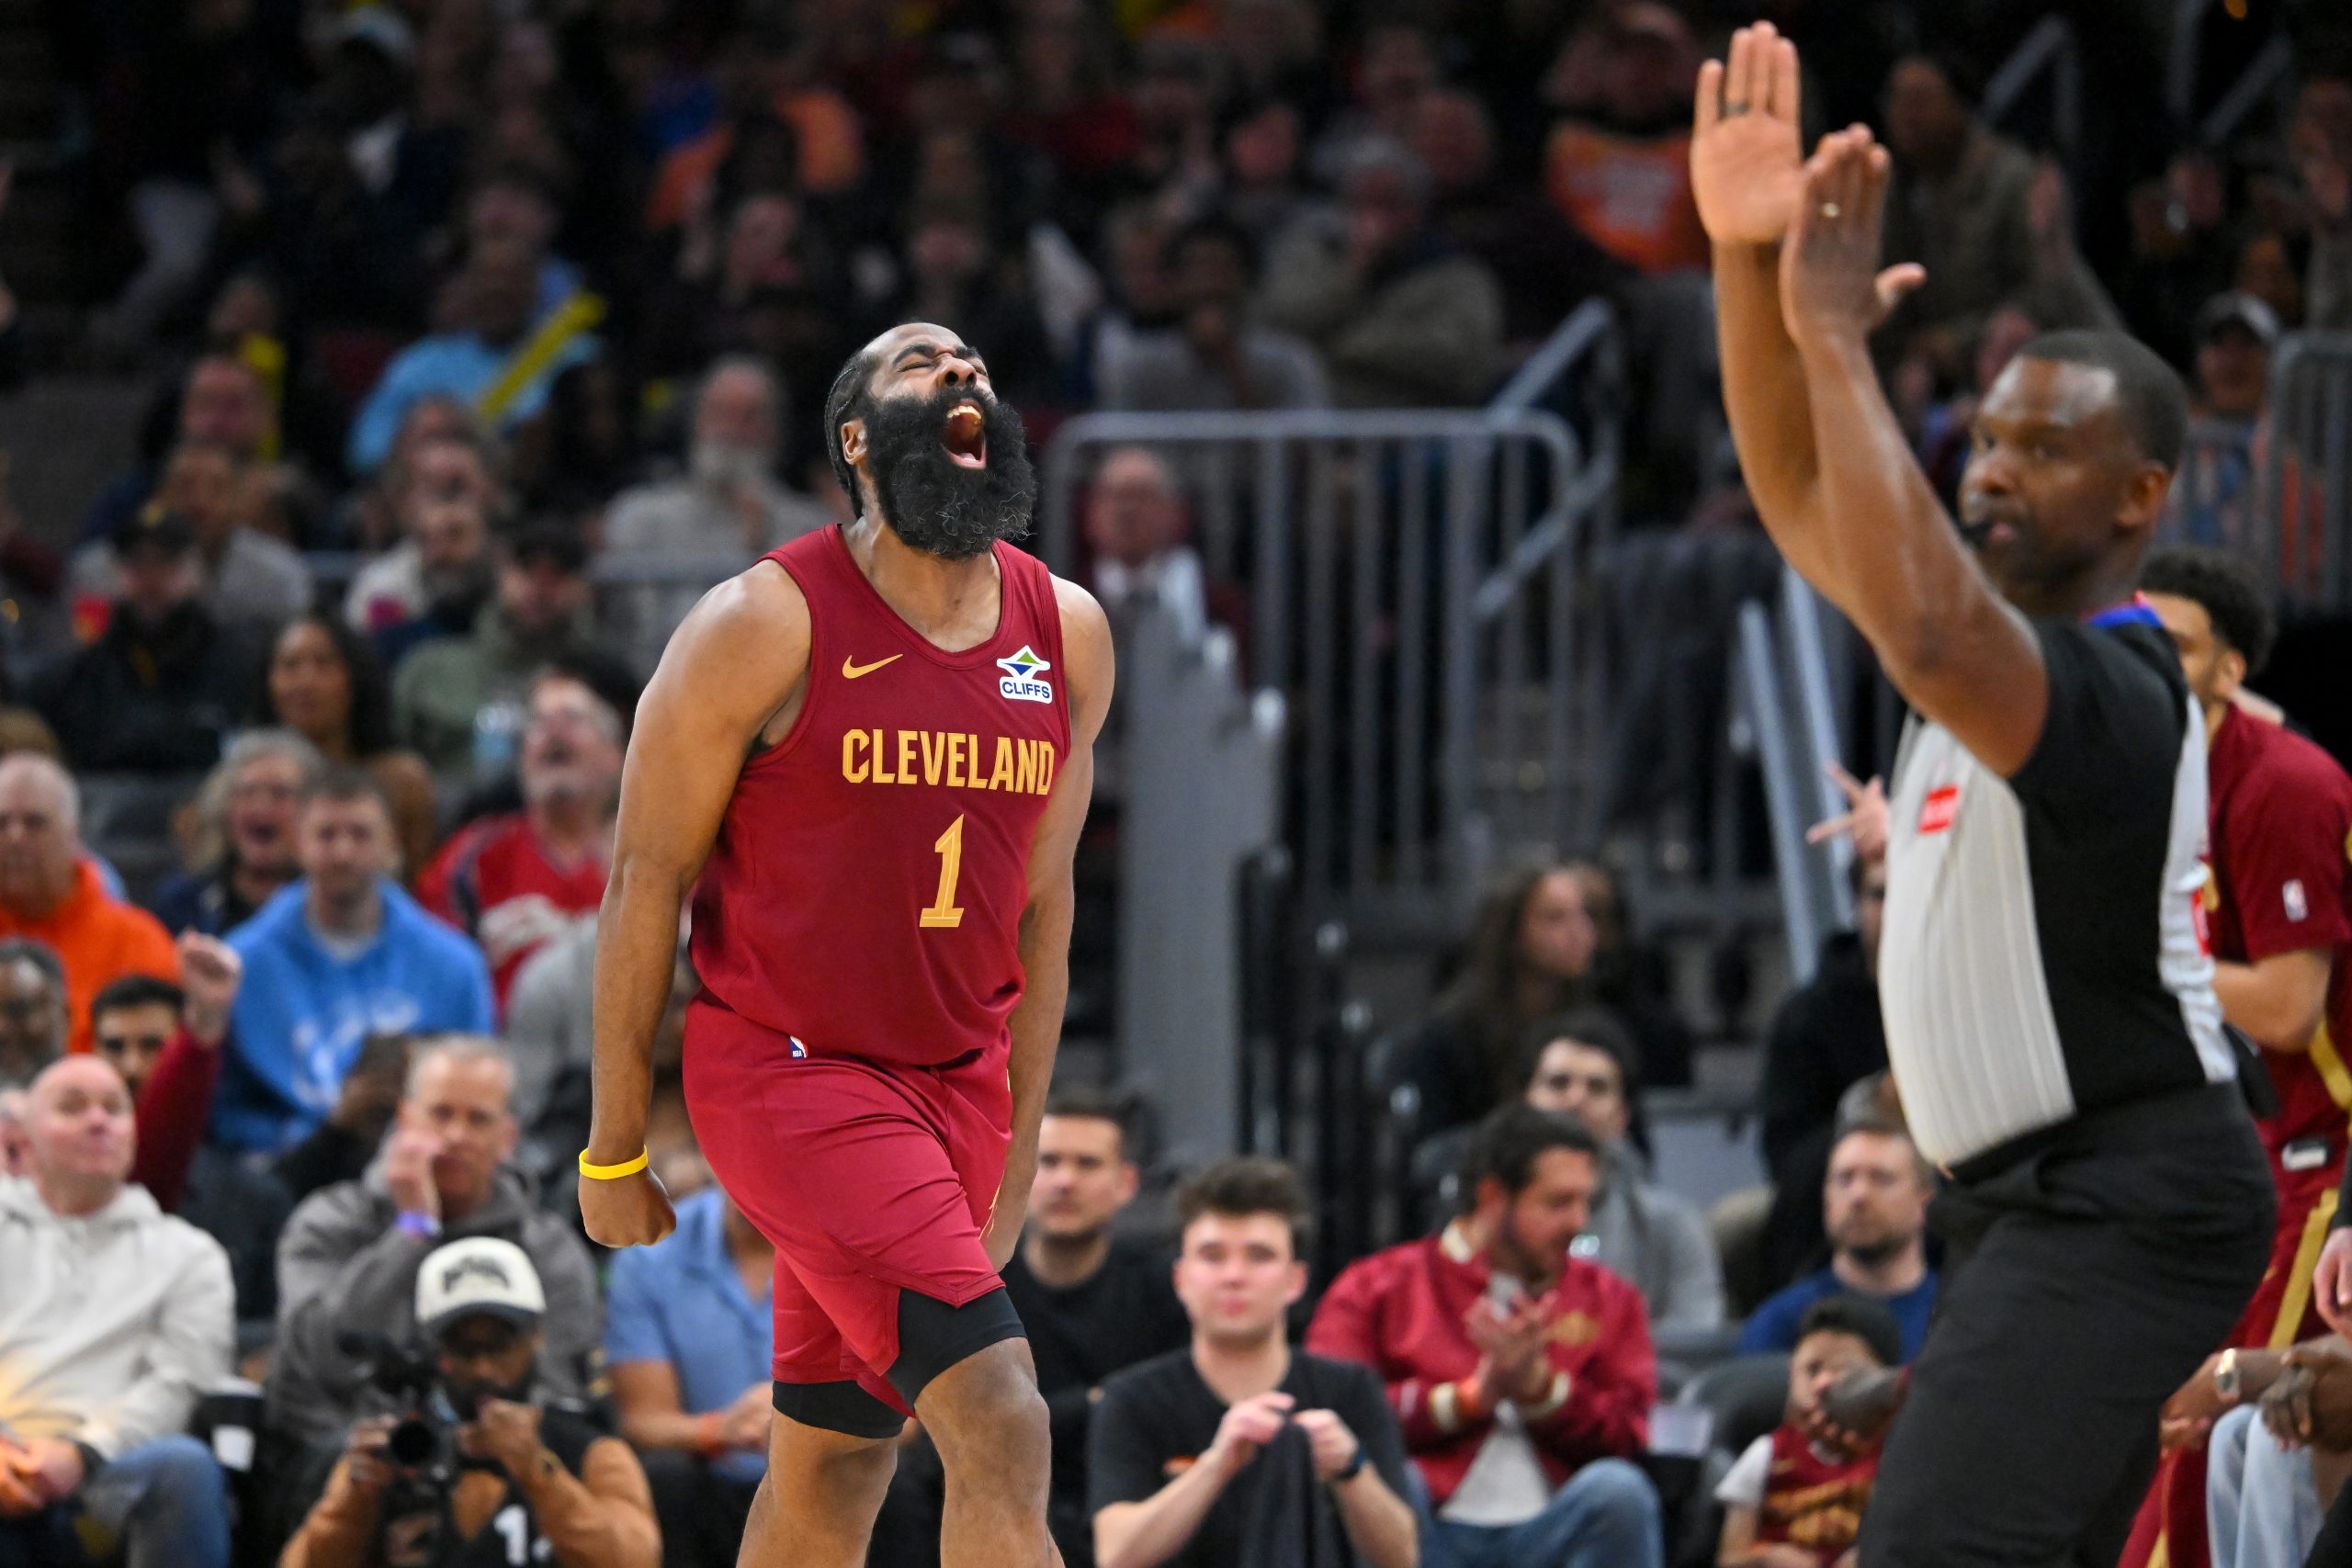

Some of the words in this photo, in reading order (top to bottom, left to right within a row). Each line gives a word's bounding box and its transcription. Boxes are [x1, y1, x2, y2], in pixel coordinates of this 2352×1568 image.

[1001, 681, 1050, 699] CLIFFS
[842, 728, 1055, 795] CLEVELAND
[919, 813, 965, 928] 1
